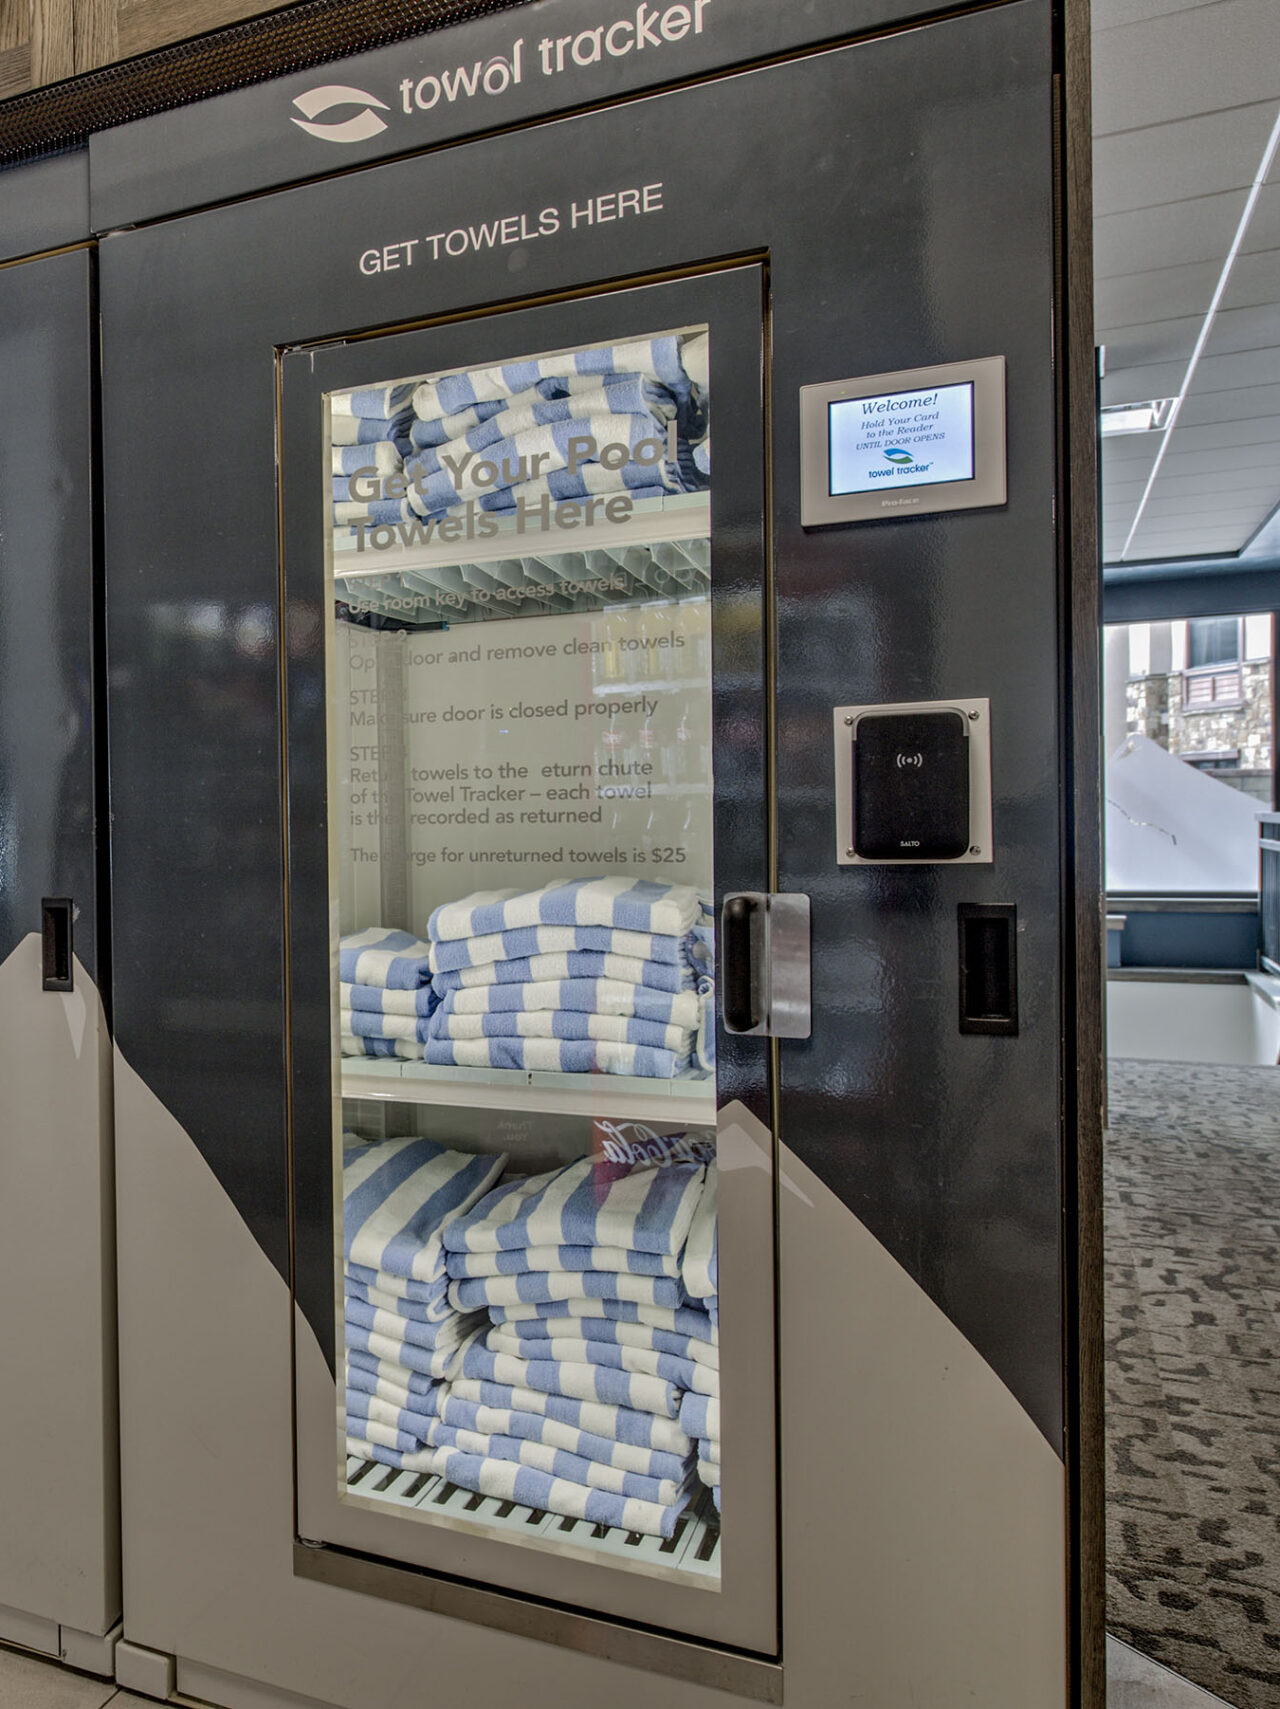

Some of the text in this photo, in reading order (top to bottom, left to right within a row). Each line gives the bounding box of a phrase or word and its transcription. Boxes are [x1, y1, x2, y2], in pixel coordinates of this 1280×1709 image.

[538, 0, 711, 76] tracker
[360, 182, 664, 276] GET TOWELS HERE
[862, 393, 938, 415] Welcome!
[861, 411, 939, 431] Hold Your Card
[866, 423, 933, 439] to the Reader
[856, 432, 945, 451] UNTIL DOOR OPENS
[349, 419, 678, 503] Get Your Pool
[868, 466, 894, 479] towel
[349, 491, 634, 553] Towels Here
[348, 573, 625, 614] Use room key to access towels
[448, 645, 481, 663] and
[487, 644, 557, 660] remove
[563, 638, 612, 656] clean
[619, 630, 686, 651] towels
[402, 710, 437, 725] sure
[442, 705, 485, 722] door
[490, 704, 504, 720] is
[509, 699, 568, 718] closed
[574, 695, 659, 720] properly
[411, 763, 469, 781] towels
[473, 764, 493, 779] to
[498, 762, 529, 778] the
[539, 763, 592, 778] eturn
[598, 759, 653, 777] chute
[350, 787, 368, 805] of
[405, 785, 454, 803] Towel
[459, 784, 525, 802] Tracker
[546, 782, 590, 800] each
[596, 781, 651, 799] towel
[350, 810, 362, 825] is
[410, 807, 489, 825] recorded
[495, 810, 514, 824] as
[520, 805, 602, 823] returned
[350, 848, 378, 863] The
[440, 846, 464, 862] for
[469, 846, 563, 863] unreturned
[569, 848, 627, 863] towels
[633, 848, 646, 863] is
[651, 847, 686, 864] $25
